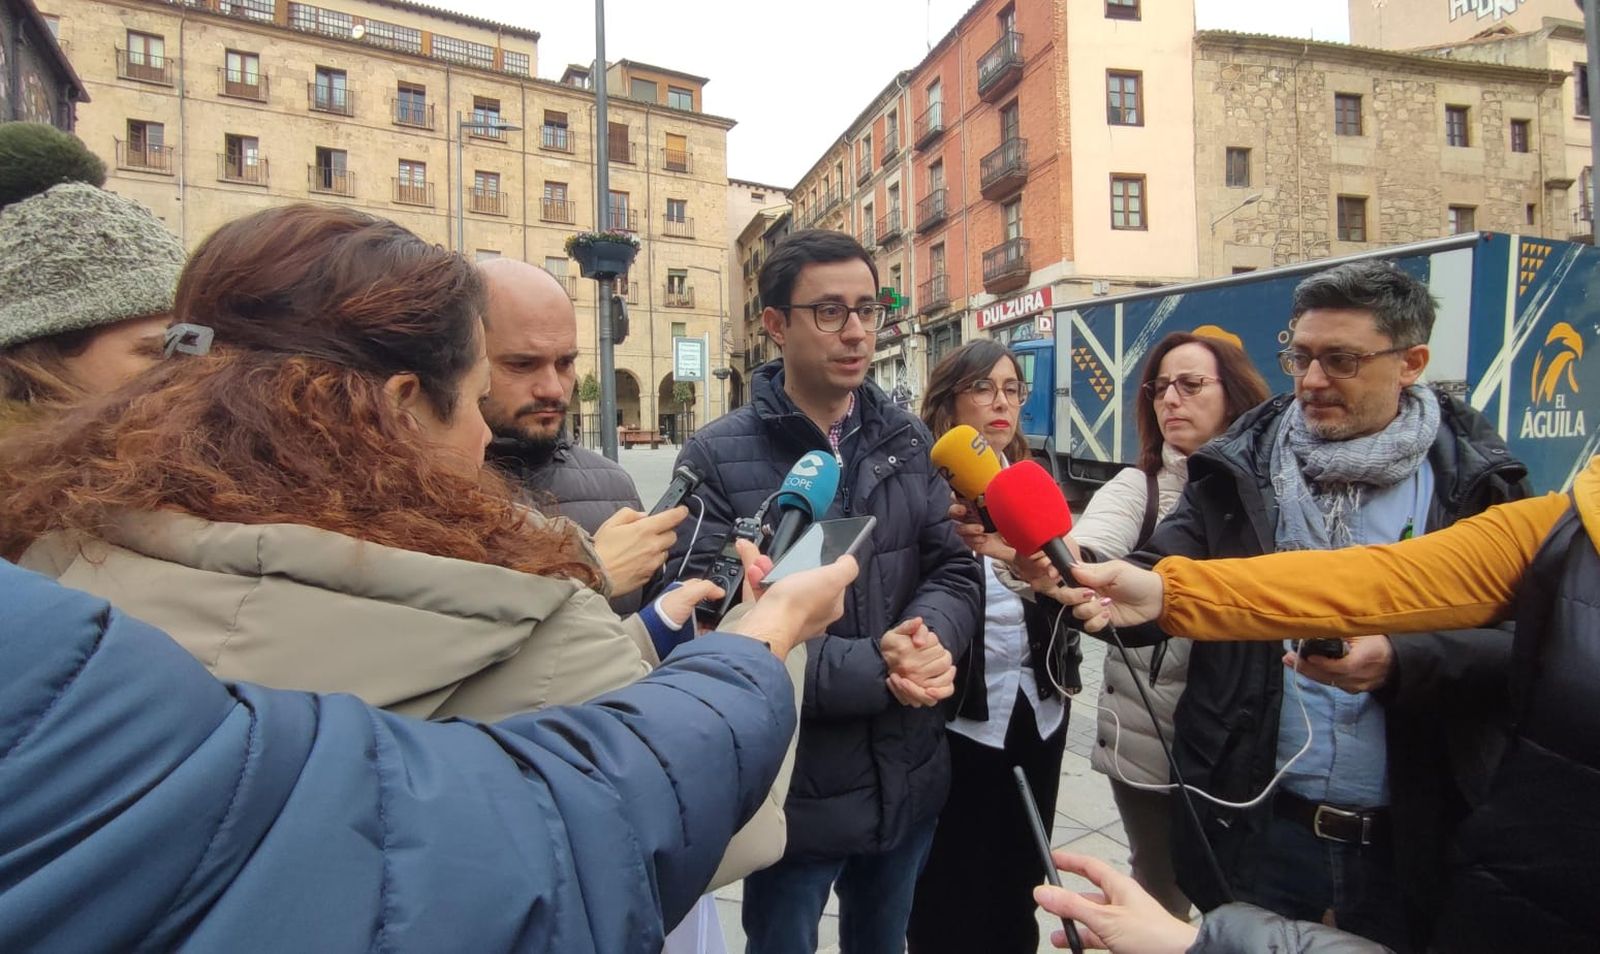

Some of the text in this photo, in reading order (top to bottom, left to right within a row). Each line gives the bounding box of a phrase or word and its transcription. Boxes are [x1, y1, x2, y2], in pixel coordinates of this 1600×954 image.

[982, 291, 1045, 327] DULZURA
[1555, 394, 1566, 409] EL
[1520, 406, 1586, 438] ÁGUILA
[783, 477, 813, 491] COPE
